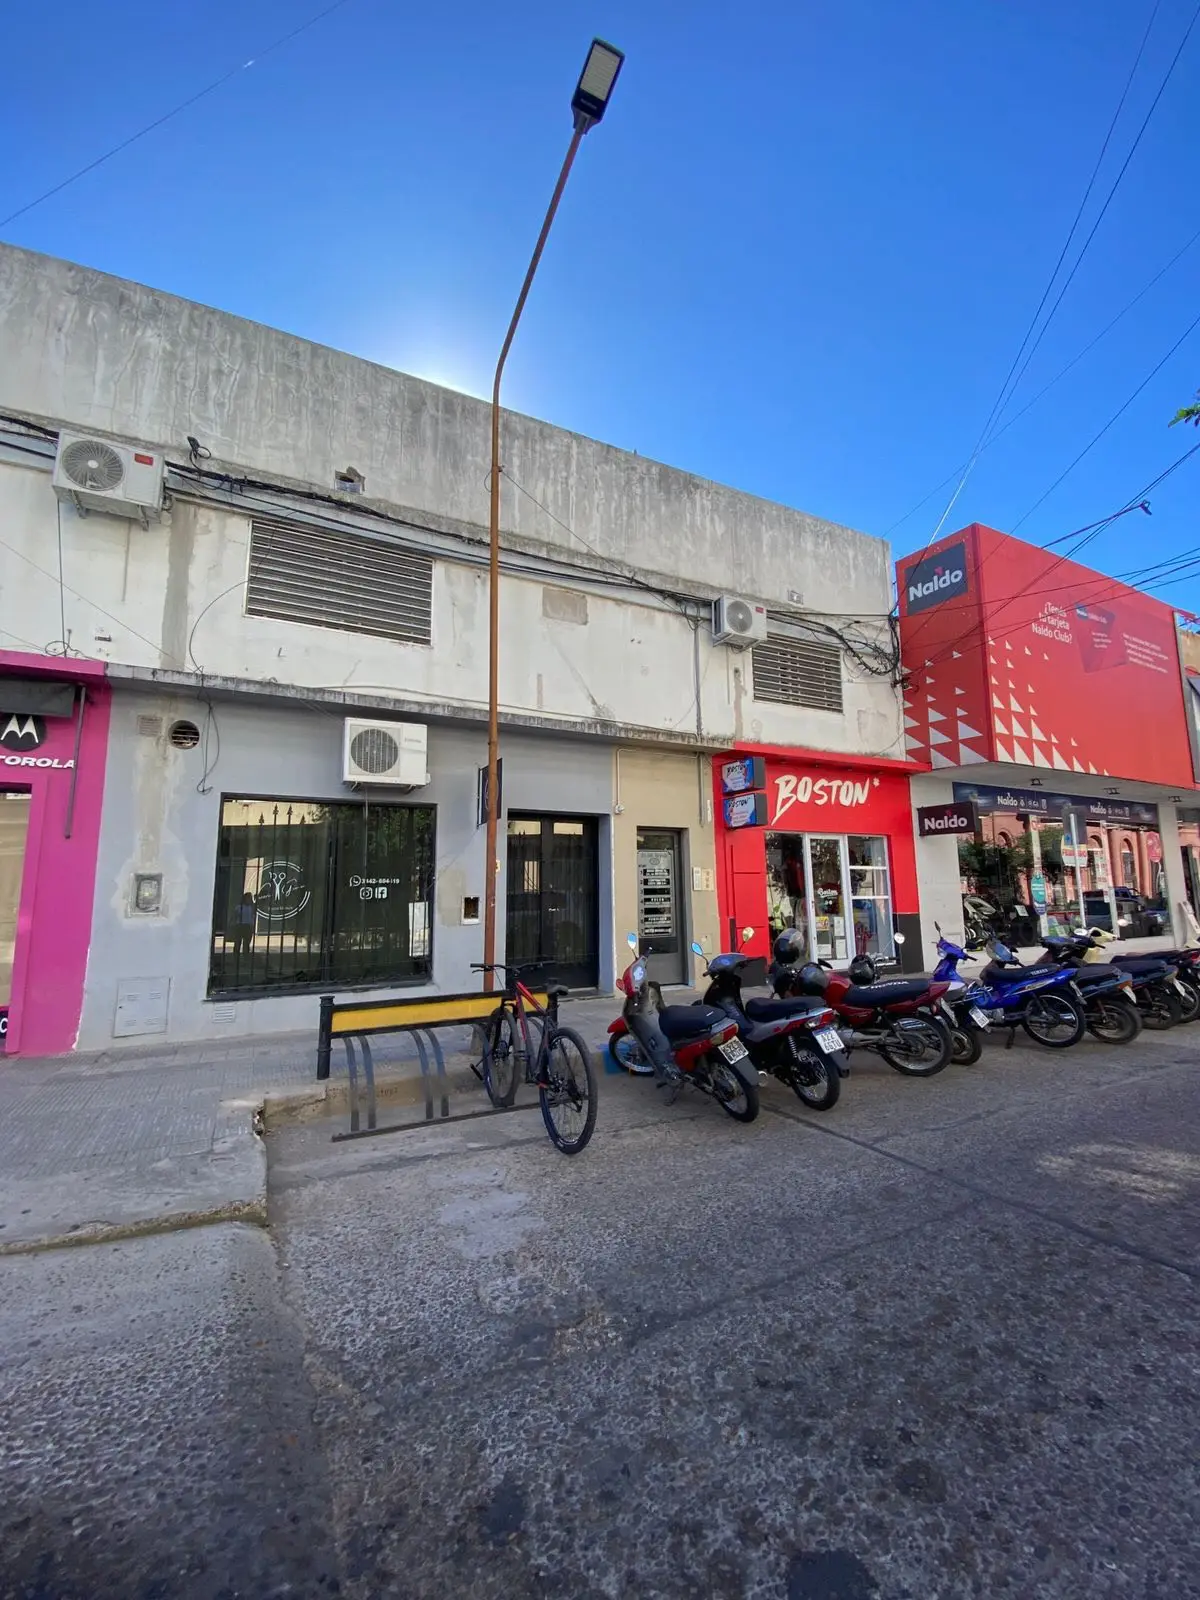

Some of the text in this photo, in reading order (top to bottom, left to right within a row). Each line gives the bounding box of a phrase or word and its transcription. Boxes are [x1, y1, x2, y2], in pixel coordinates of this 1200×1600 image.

[909, 569, 963, 602] Naldo
[1031, 621, 1053, 638] Naldo
[1053, 629, 1073, 644] Club?
[771, 774, 870, 826] BOSTON
[997, 792, 1018, 806] Naldo
[924, 815, 968, 830] Naldo
